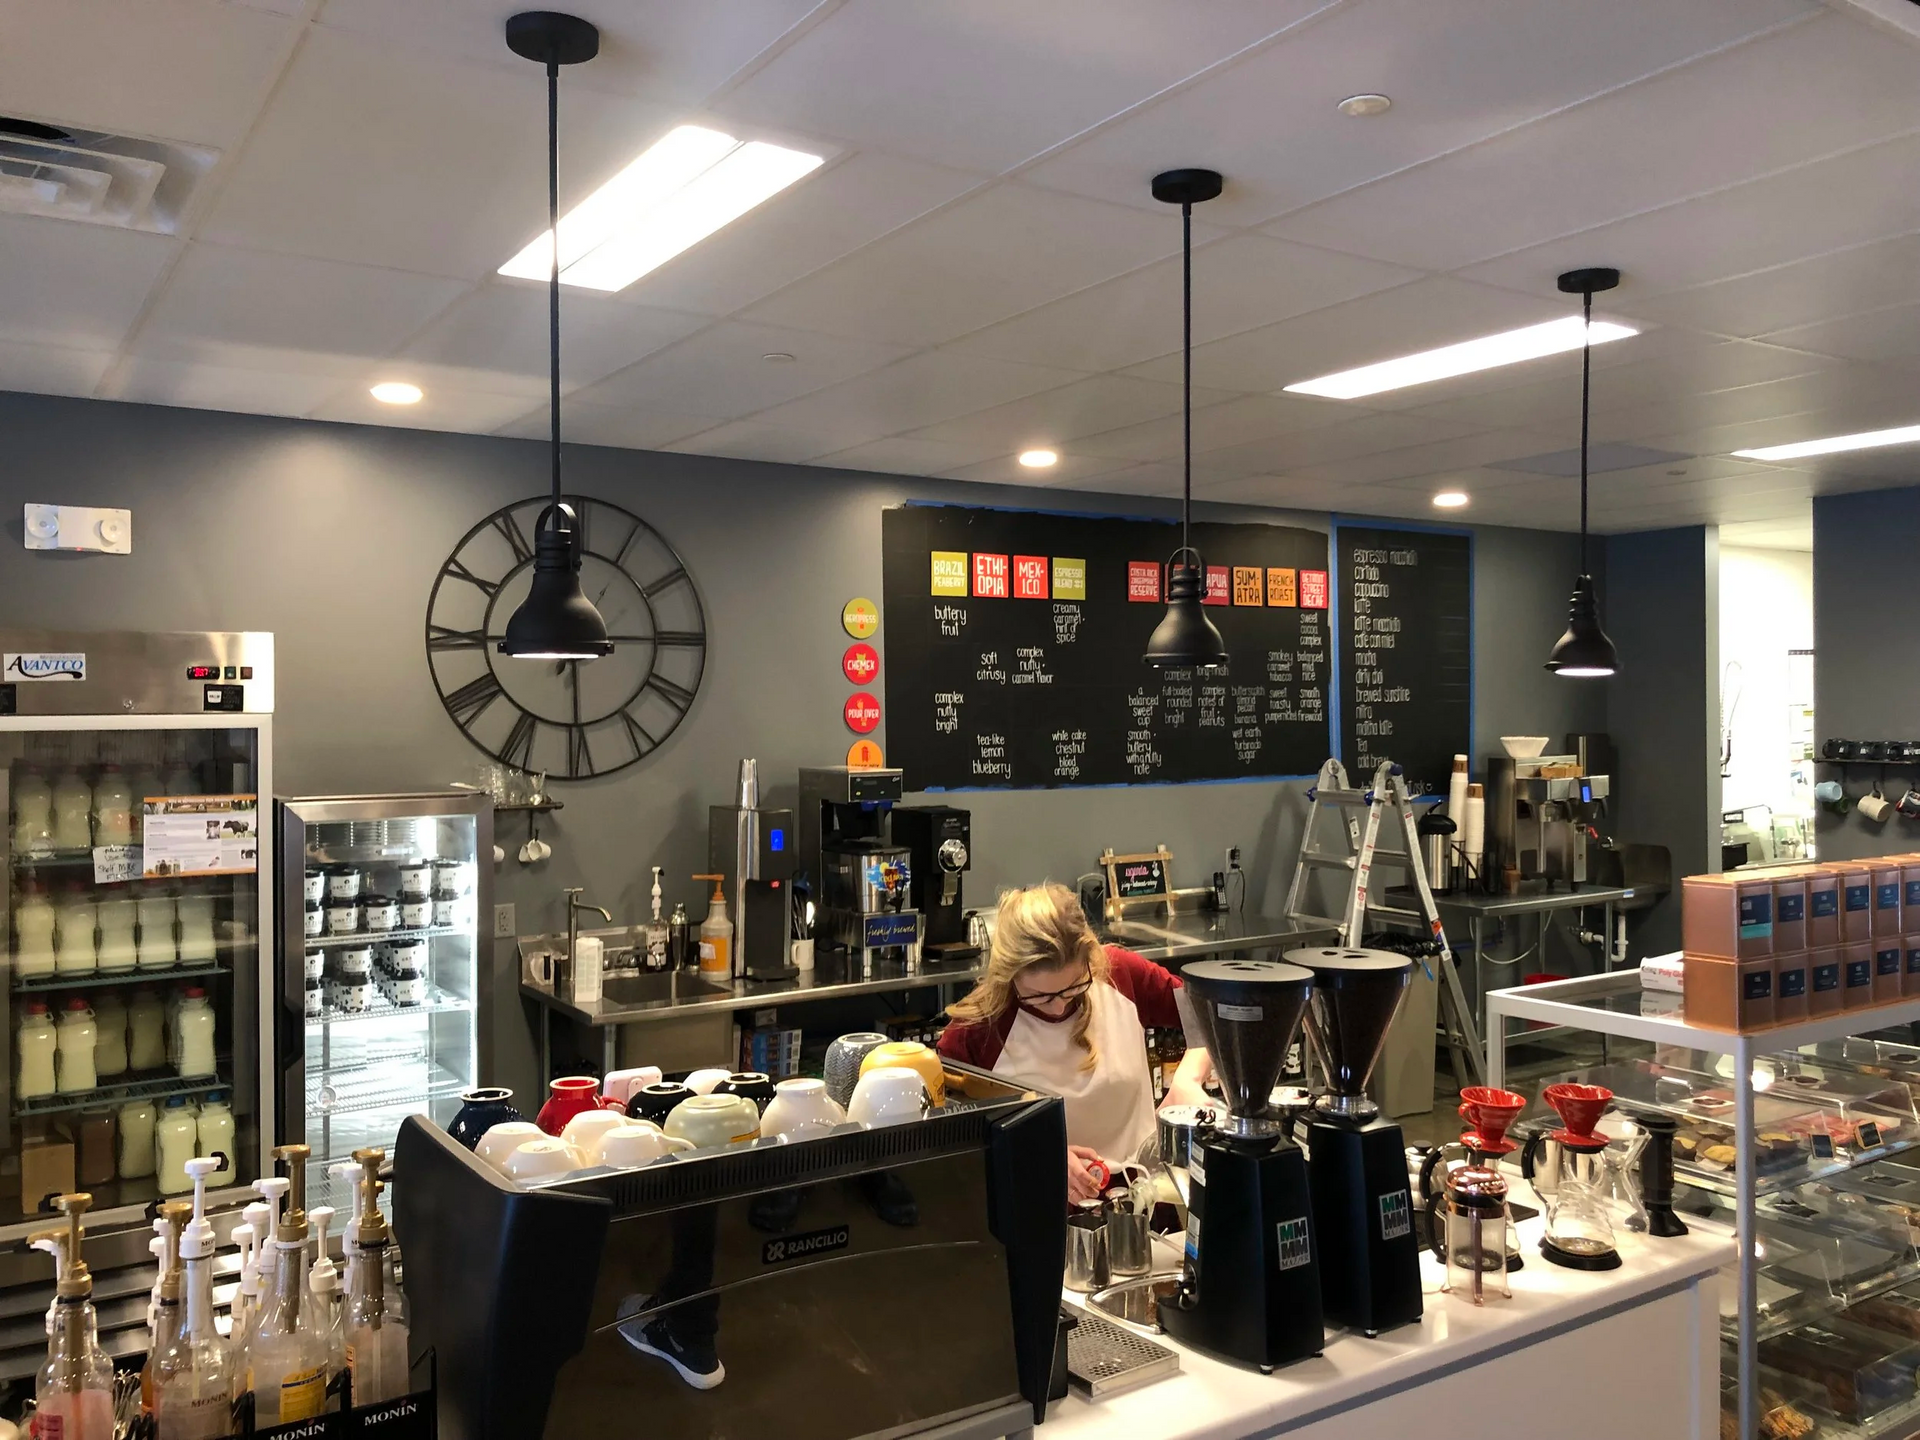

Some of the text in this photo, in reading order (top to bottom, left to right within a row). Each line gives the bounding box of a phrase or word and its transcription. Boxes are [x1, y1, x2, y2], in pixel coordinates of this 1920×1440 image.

[1353, 548, 1389, 565] espresso
[933, 560, 966, 577] BRAZIL
[976, 555, 1008, 576] ETHI-
[1018, 561, 1045, 579] MEX-
[1054, 567, 1083, 578] ESPRESSO
[977, 575, 1004, 596] OPIA
[1206, 573, 1228, 588] APUA
[1236, 570, 1260, 586] SUM-
[1268, 574, 1294, 587] FRENCH
[1022, 578, 1040, 595] ICO
[1130, 585, 1158, 597] RESERVE
[1302, 583, 1325, 595] STREET
[1236, 587, 1261, 604] ATRA
[1269, 588, 1294, 602] ROAST
[1302, 594, 1325, 607] DECAF
[934, 604, 967, 626] buttery
[1052, 603, 1081, 615] creamy
[941, 620, 959, 637] fruit
[1055, 633, 1077, 645] spice
[1300, 634, 1322, 648] complex
[980, 651, 998, 666] soft
[1016, 646, 1044, 660] complex
[1355, 650, 1377, 666] mocha
[6, 656, 84, 675] AVANTCO
[847, 660, 875, 671] CHEMEX
[976, 668, 1006, 686] citrusy
[1269, 672, 1293, 682] tobacco
[1355, 668, 1371, 687] dirty
[934, 690, 964, 707] complex
[1127, 694, 1159, 706] balanced
[1202, 686, 1227, 699] complex
[1355, 686, 1411, 703] brewed sunshine
[1166, 696, 1193, 708] rounded
[1299, 699, 1322, 713] orange
[848, 707, 880, 719] POUR OVER
[1132, 705, 1153, 717] sweet
[1201, 707, 1215, 718] fruit
[935, 718, 958, 734] bright
[1137, 716, 1151, 728] cup
[1164, 709, 1185, 729] bright
[1127, 729, 1151, 741] smooth
[980, 746, 1005, 758] lemon
[1055, 741, 1085, 755] chestnut
[1237, 750, 1257, 765] sugar
[972, 759, 1011, 780] blueberry
[1053, 766, 1080, 780] orange
[867, 923, 916, 943] freshly brewed
[787, 1231, 848, 1255] RANCILIO
[190, 1392, 228, 1408] MONIN
[364, 1403, 418, 1426] MONIN
